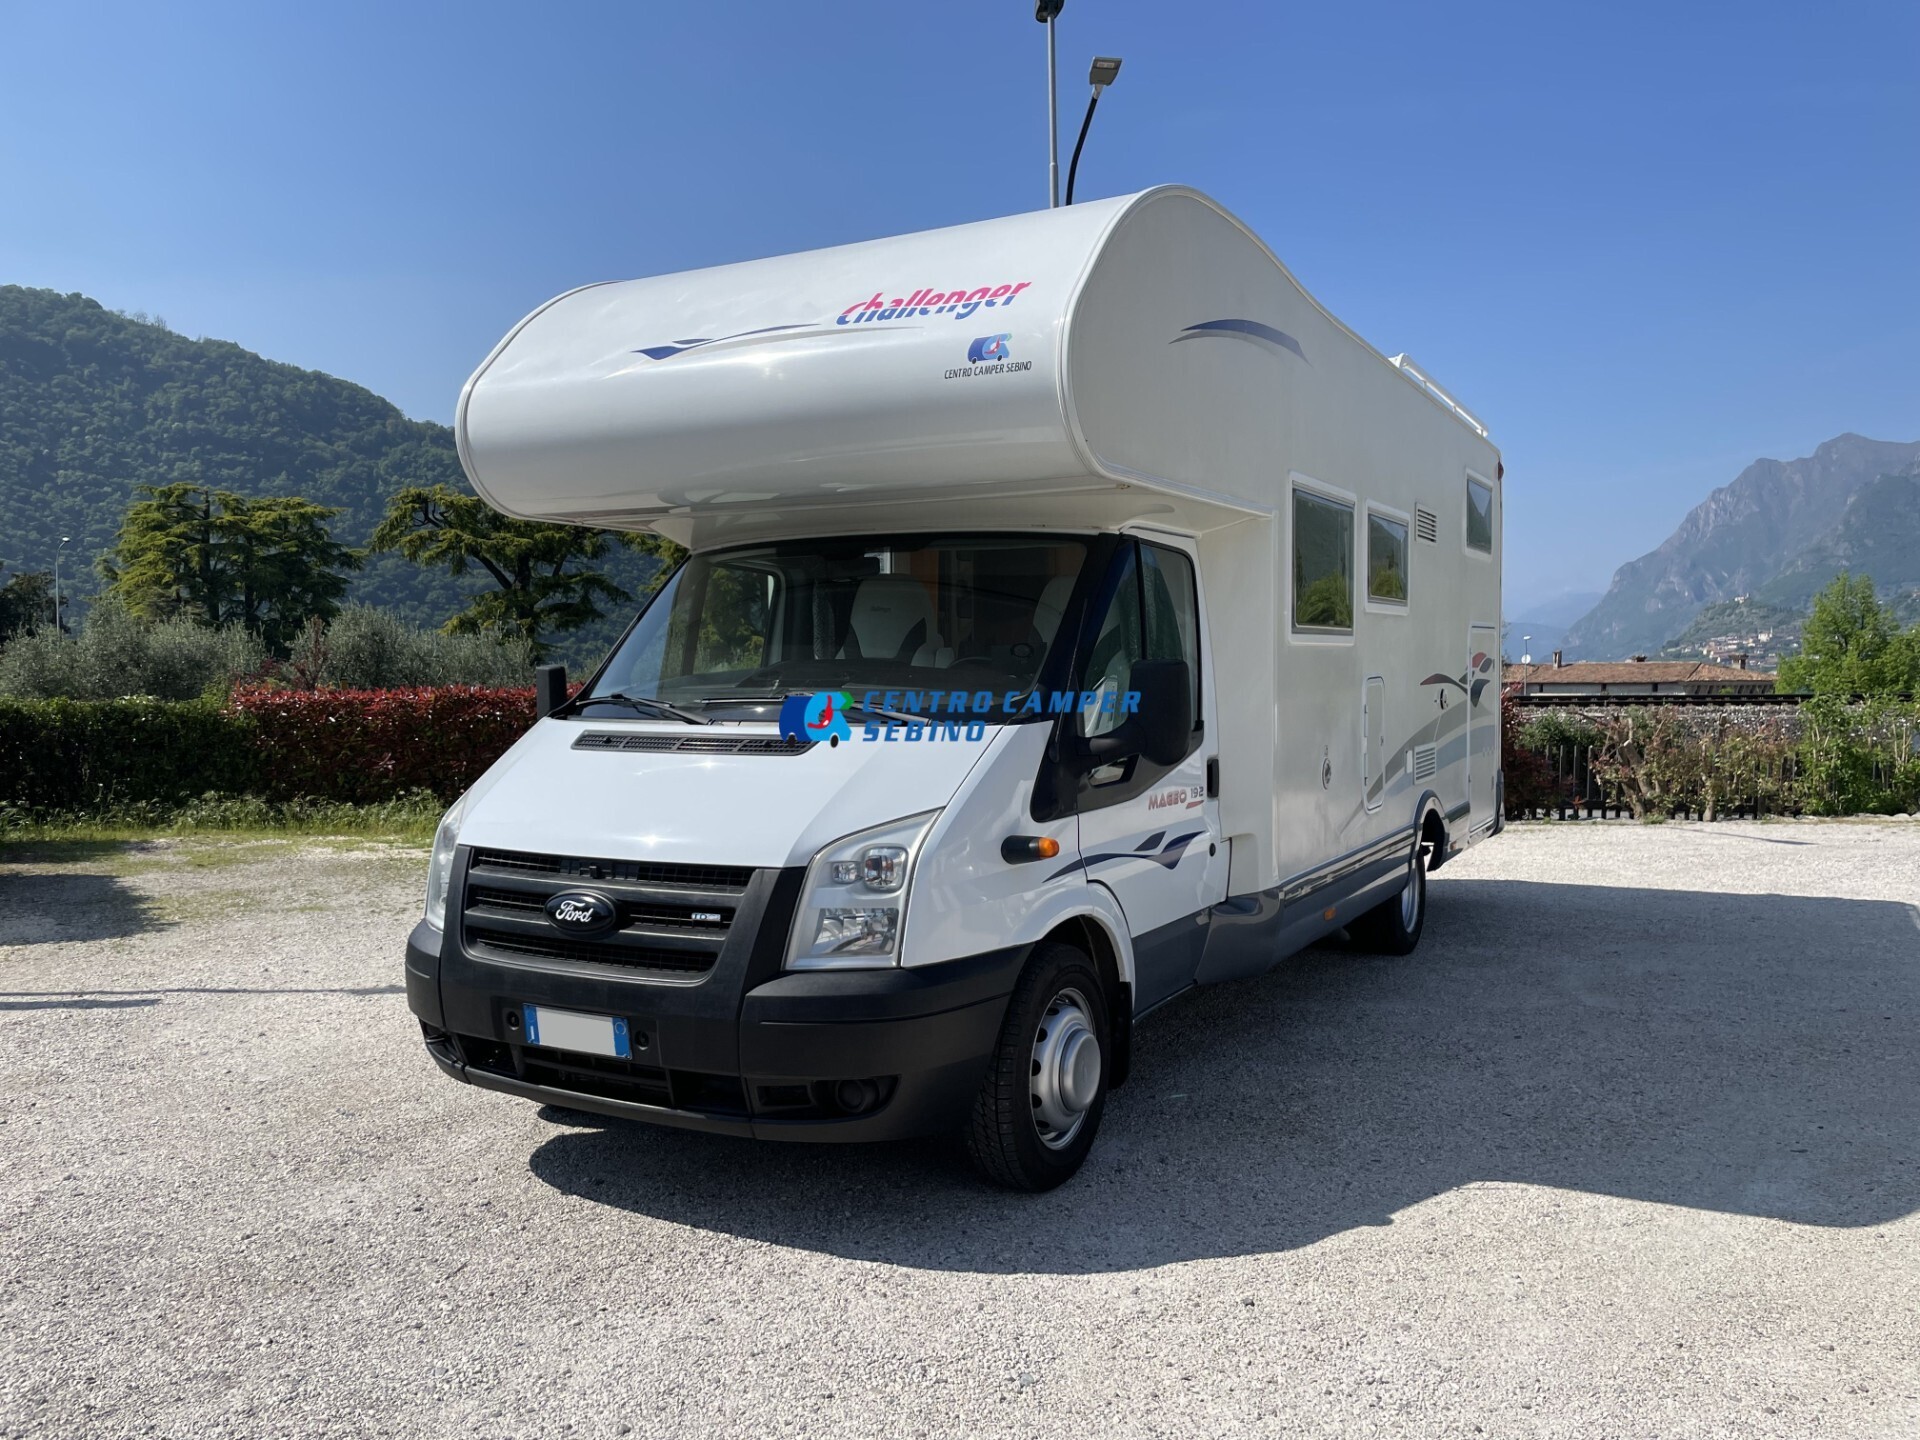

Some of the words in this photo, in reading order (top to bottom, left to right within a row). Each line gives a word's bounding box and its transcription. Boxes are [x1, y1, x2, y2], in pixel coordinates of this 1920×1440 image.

[944, 367, 972, 379] CENTRO
[973, 363, 1005, 376] CAMPER
[1006, 360, 1032, 373] SEBINO
[1190, 786, 1204, 799] 192
[555, 900, 594, 922] Ford
